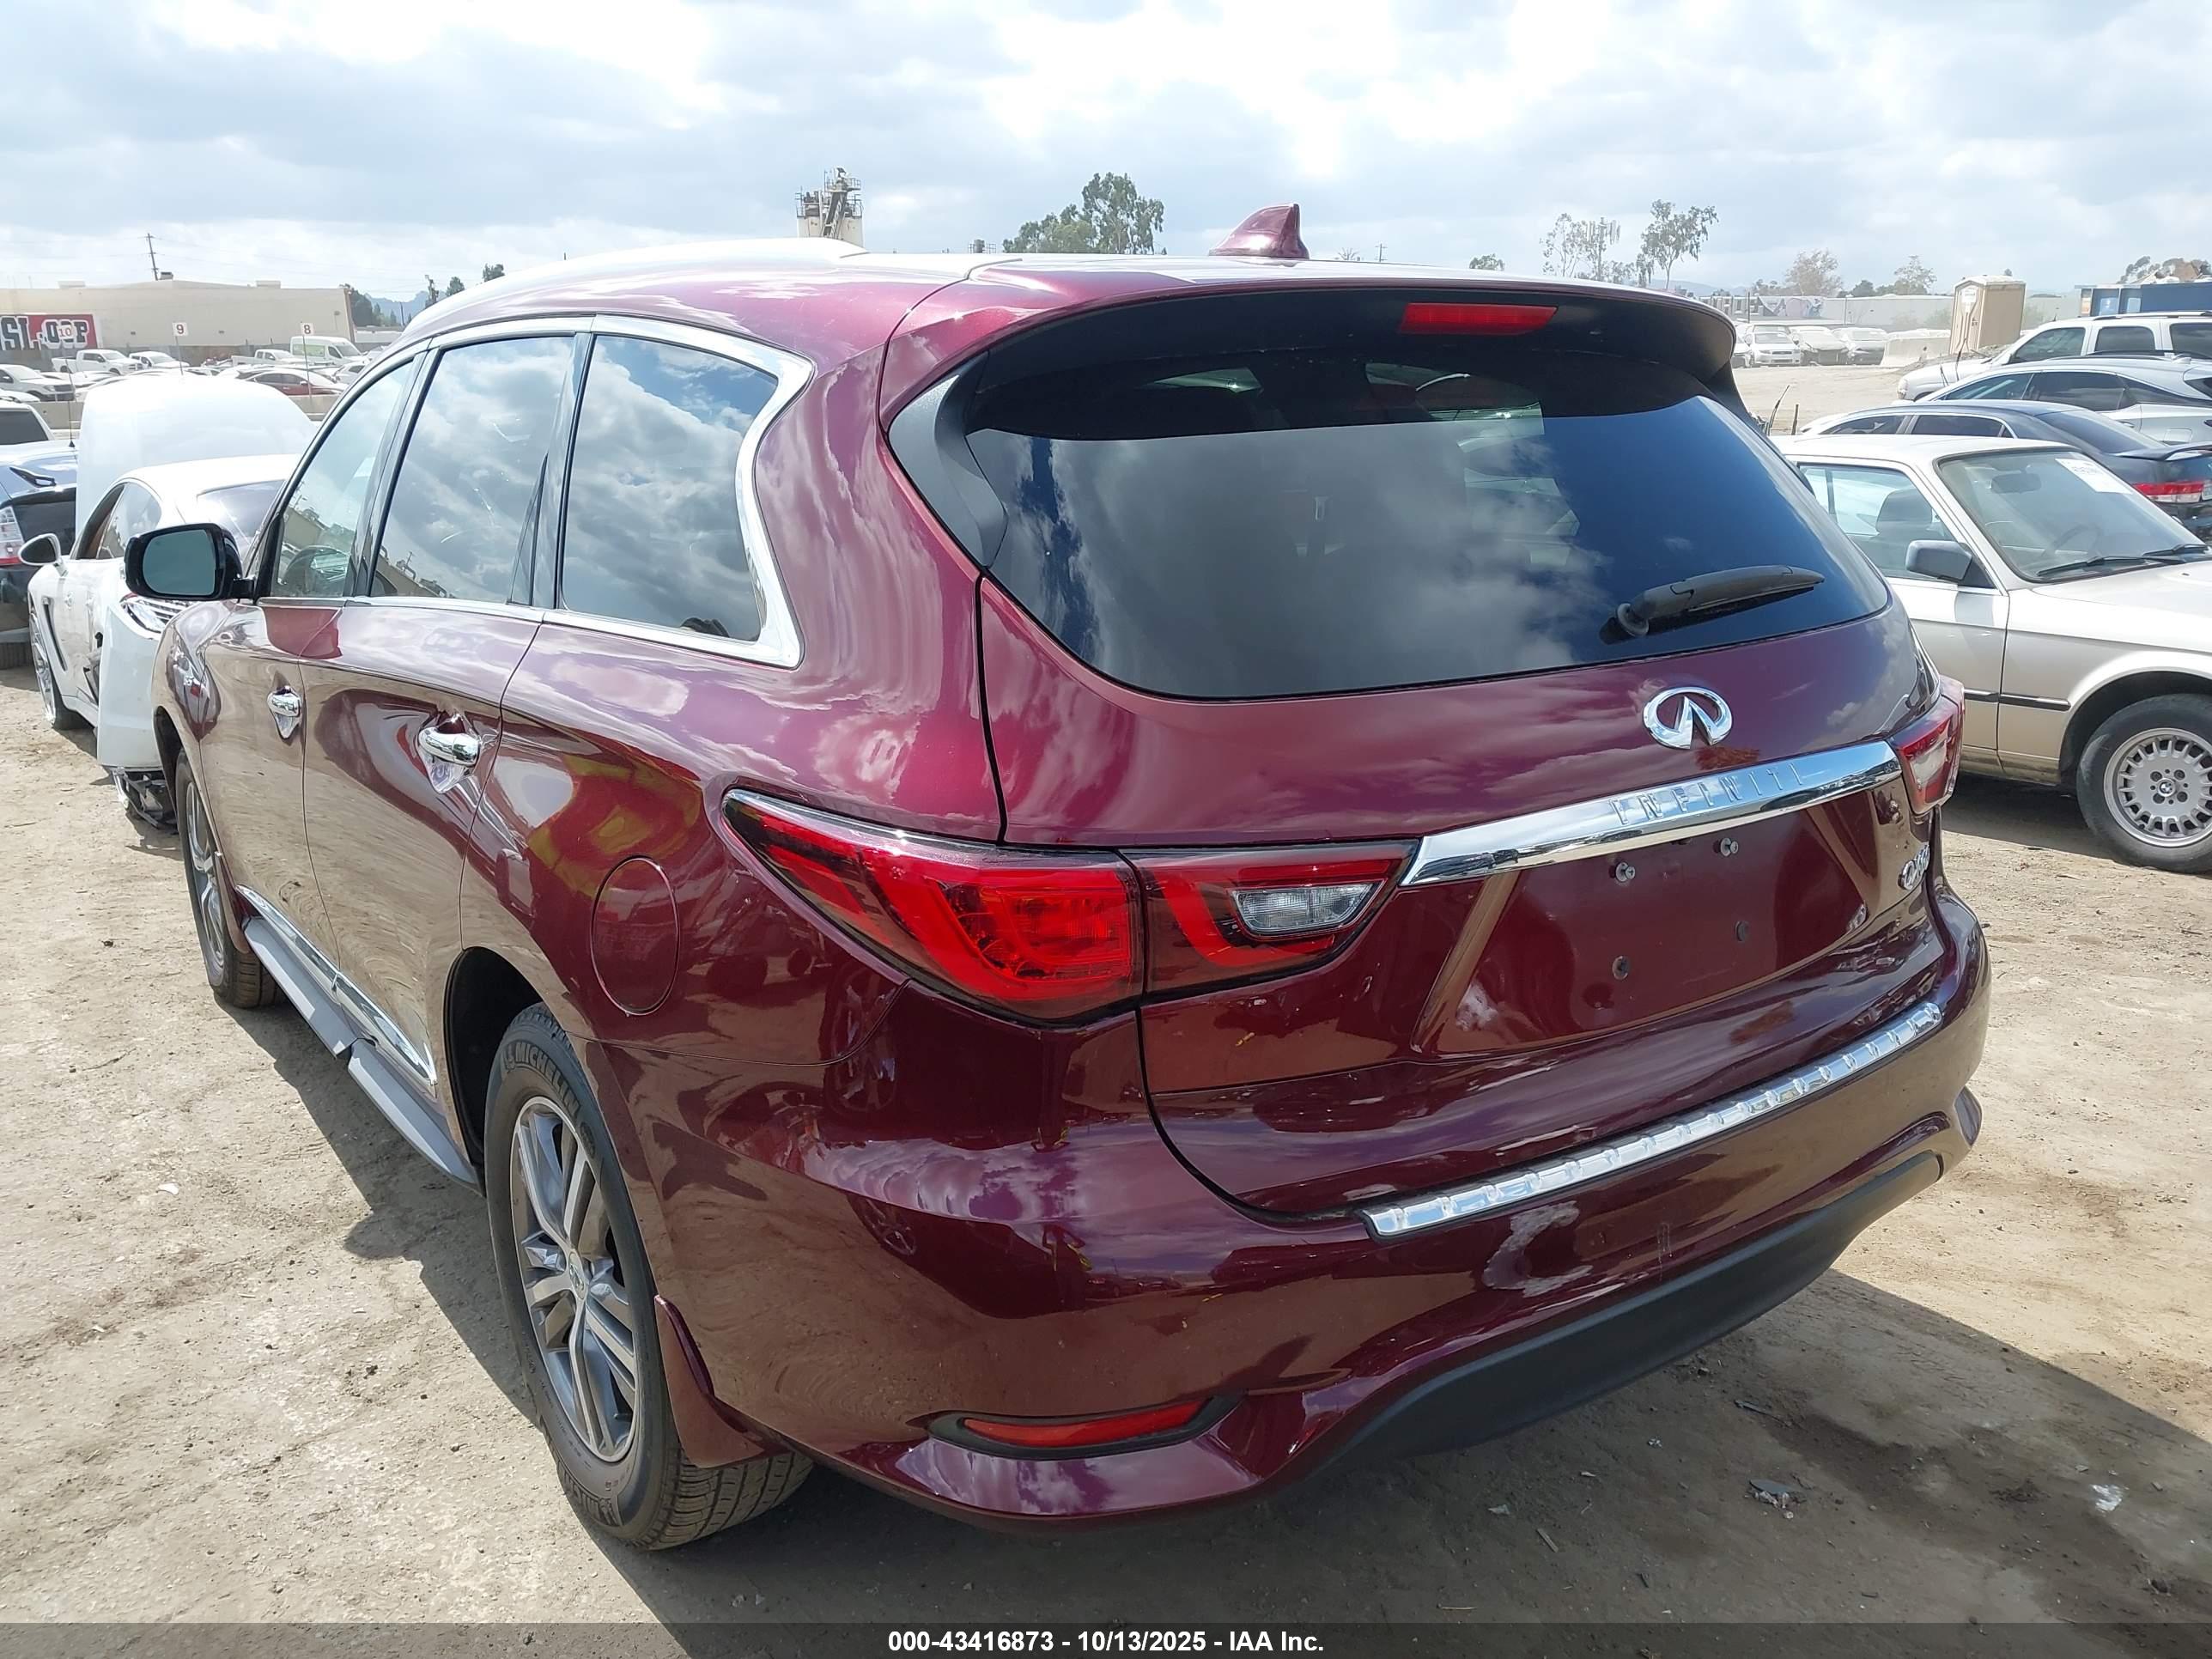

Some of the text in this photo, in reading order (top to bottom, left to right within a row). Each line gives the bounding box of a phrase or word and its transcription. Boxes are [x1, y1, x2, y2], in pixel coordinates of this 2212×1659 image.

[58, 327, 72, 337] 10
[176, 324, 185, 335] 9
[303, 324, 311, 335] 8
[1608, 762, 1803, 825] INFINITI
